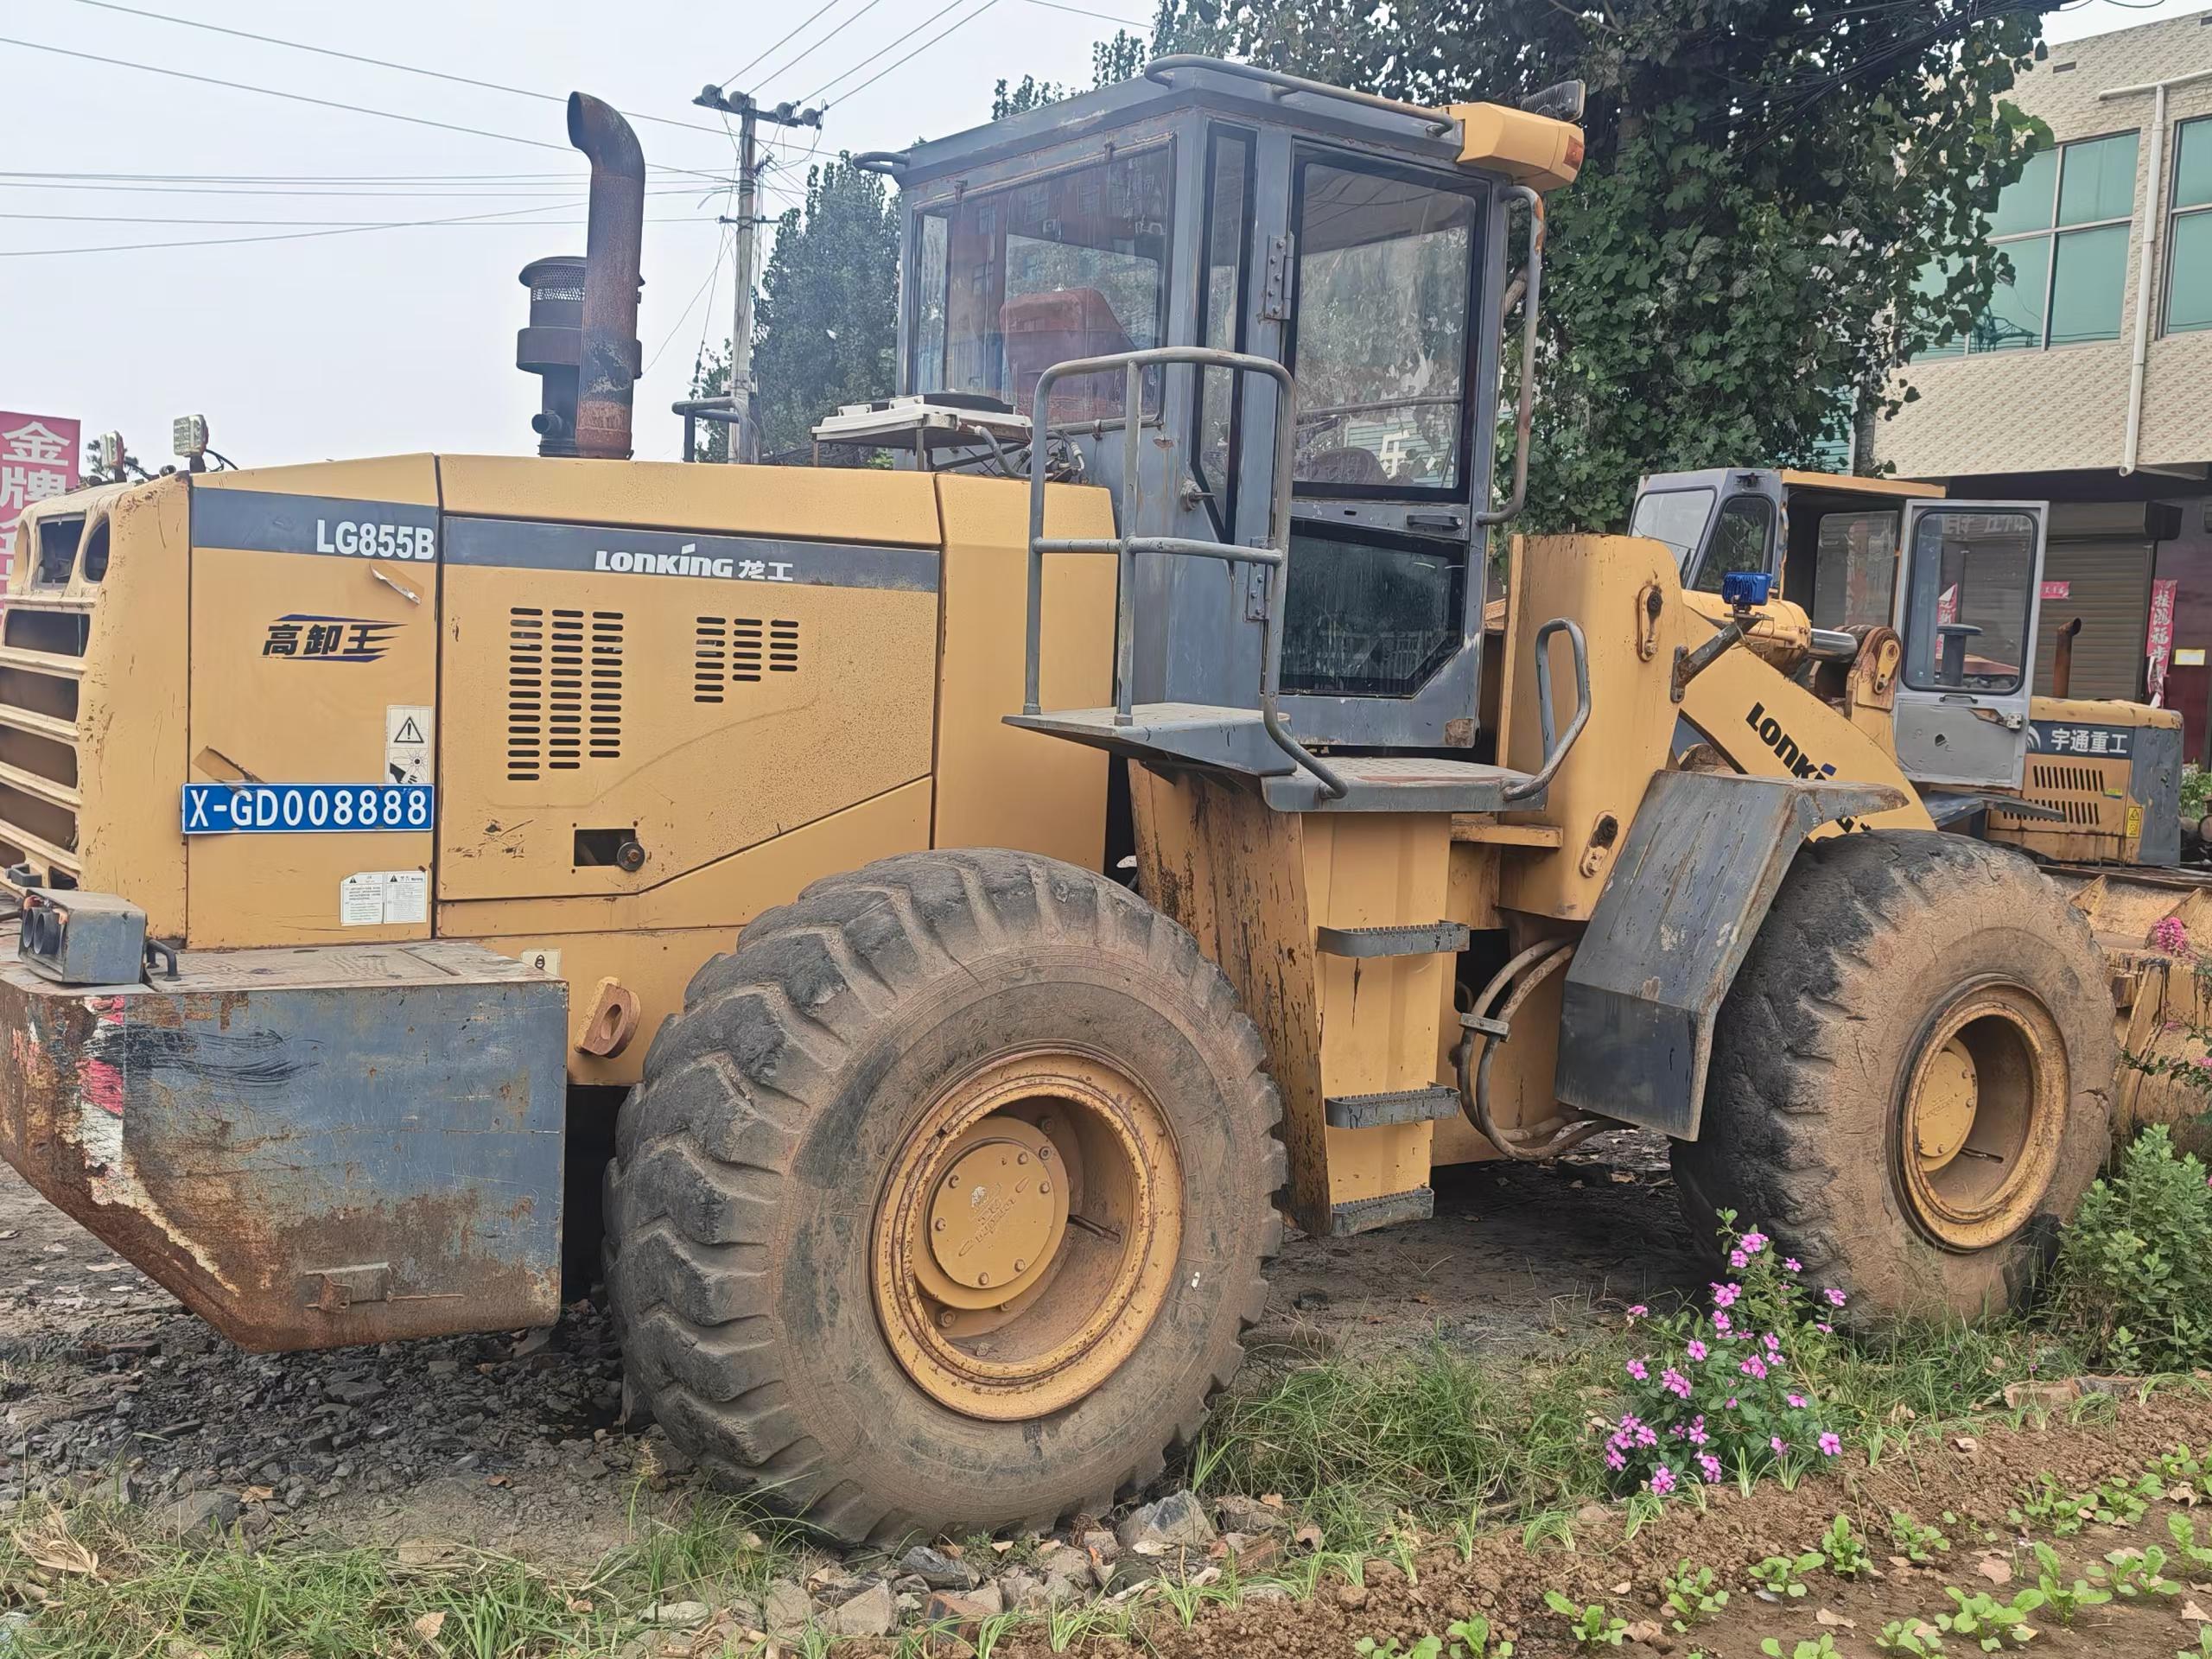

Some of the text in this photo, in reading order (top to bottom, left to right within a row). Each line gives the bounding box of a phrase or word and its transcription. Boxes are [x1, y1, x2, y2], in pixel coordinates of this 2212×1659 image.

[316, 519, 435, 561] LG855B
[738, 559, 793, 582] 龙工
[262, 623, 407, 657] 高卸王
[2050, 728, 2128, 754] 宇通重工
[189, 788, 428, 828] X-GD008888
